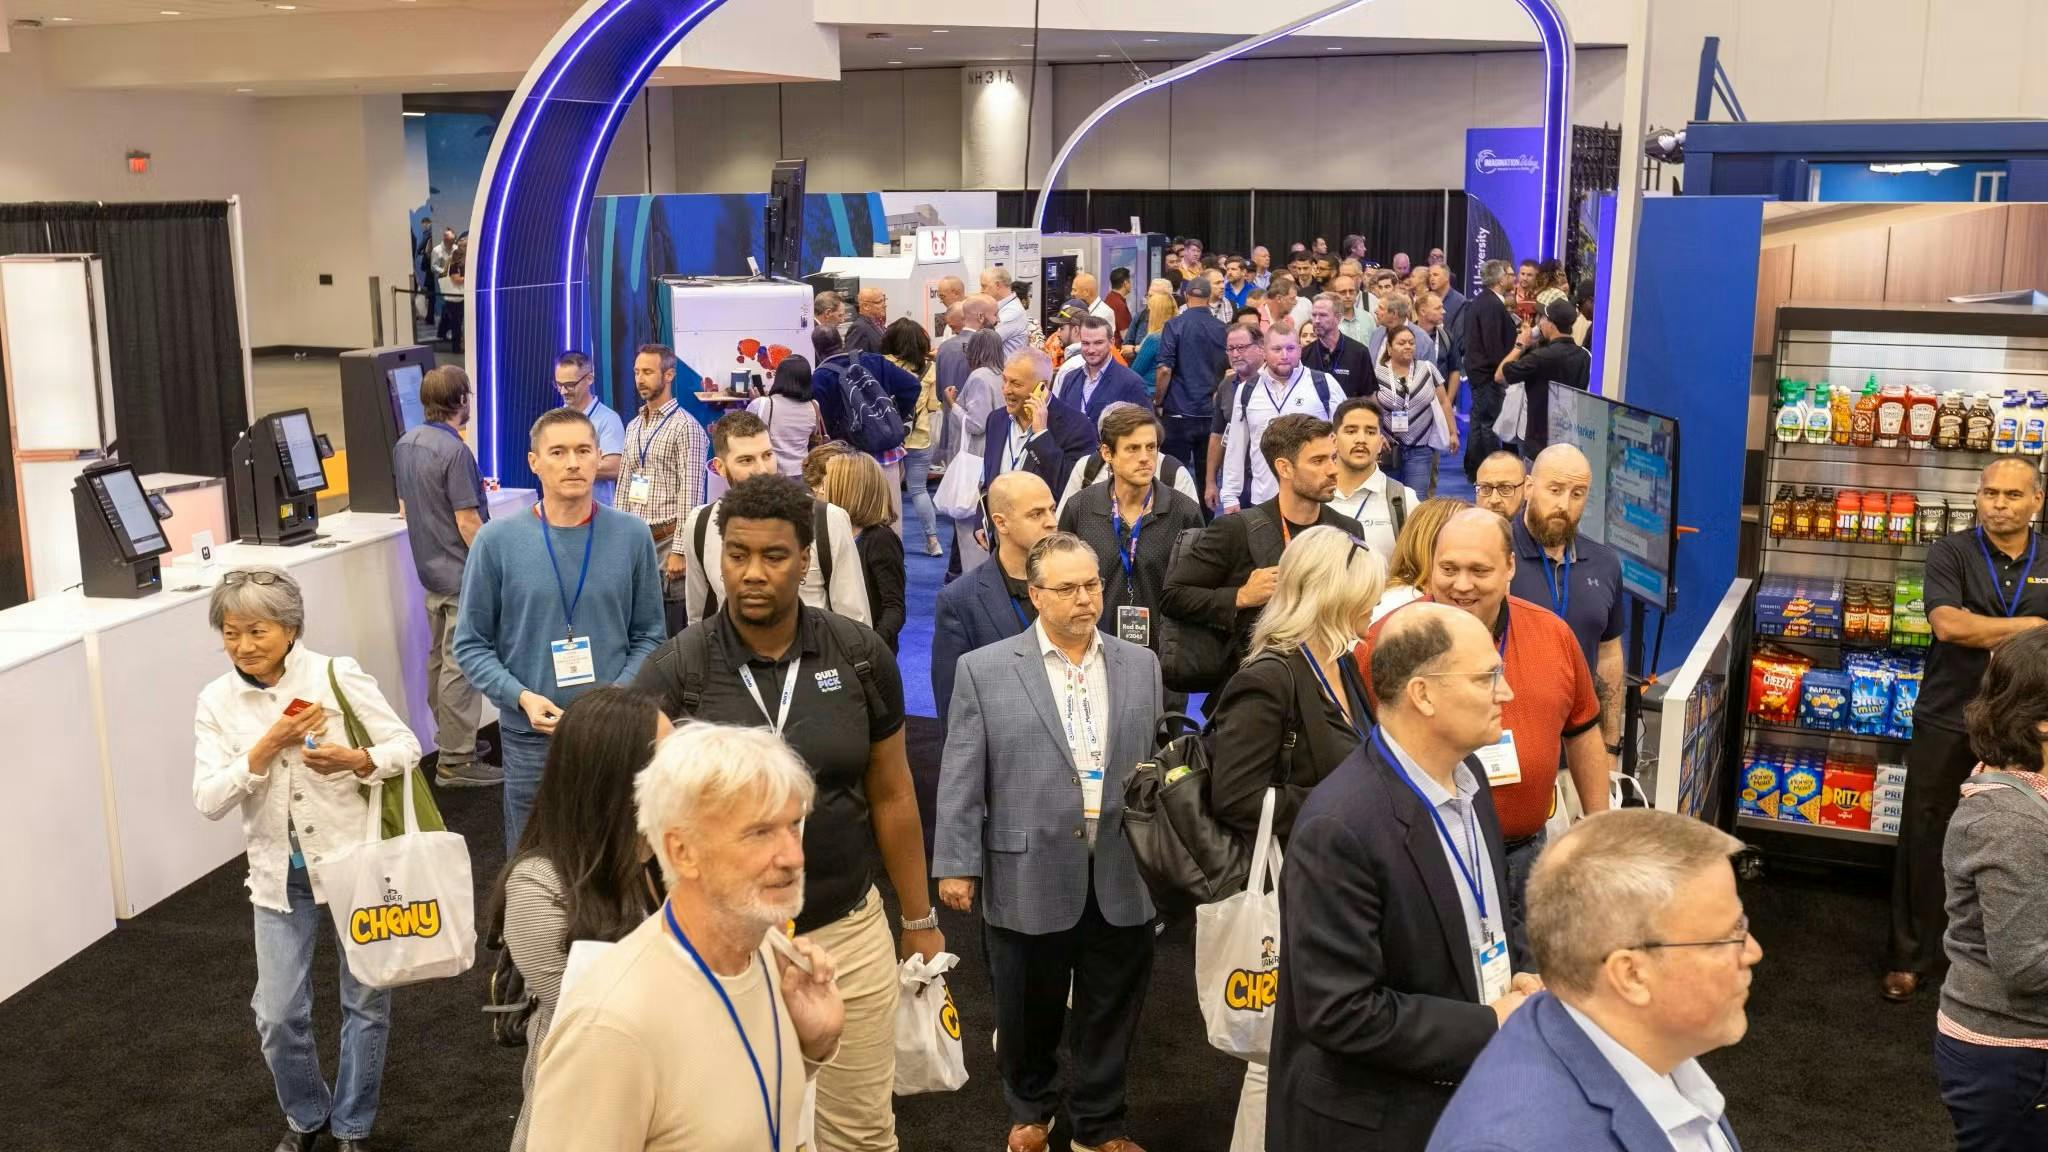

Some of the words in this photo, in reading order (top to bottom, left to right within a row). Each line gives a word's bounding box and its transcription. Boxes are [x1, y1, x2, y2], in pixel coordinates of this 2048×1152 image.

[1922, 508, 1944, 519] steep
[1951, 511, 1974, 521] steep
[1833, 787, 1861, 806] RITZ
[1225, 967, 1279, 1012] CHE
